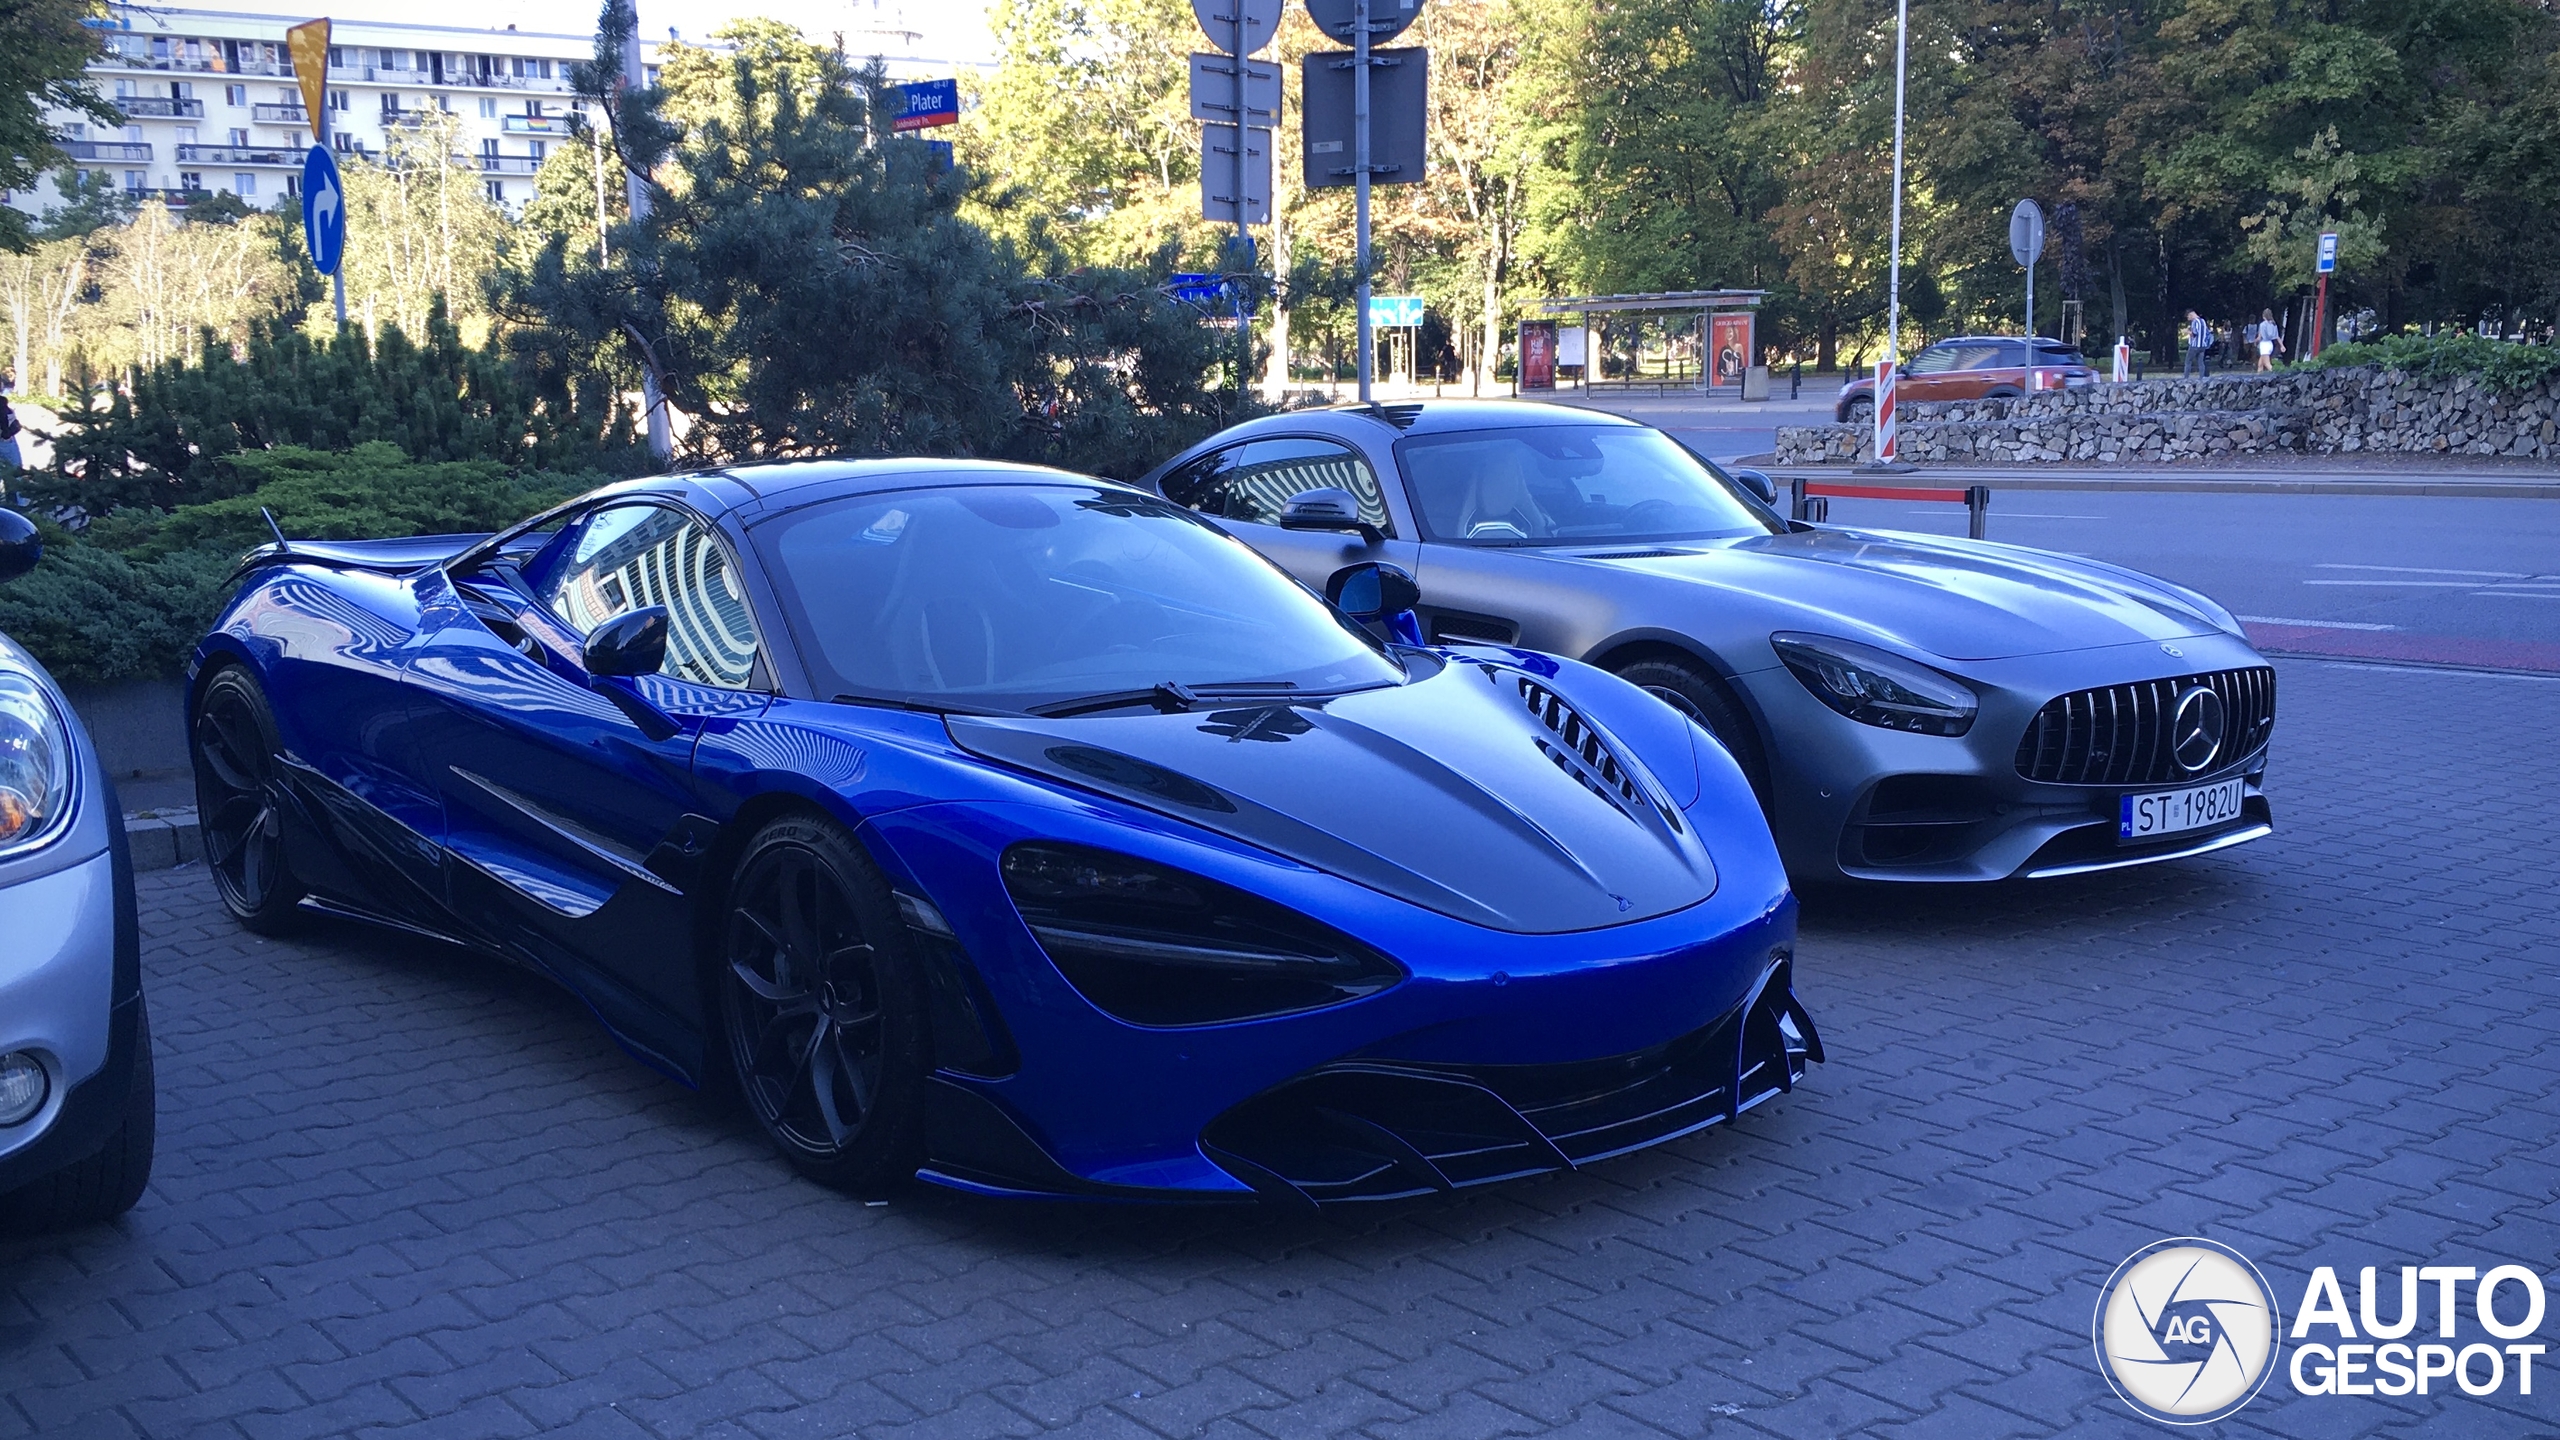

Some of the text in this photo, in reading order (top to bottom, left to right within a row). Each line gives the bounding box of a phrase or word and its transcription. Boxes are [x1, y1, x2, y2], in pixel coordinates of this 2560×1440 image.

[911, 93, 943, 112] Plater
[2138, 782, 2240, 832] ST 1982U
[760, 826, 798, 844] ZERO
[2121, 822, 2131, 832] PL
